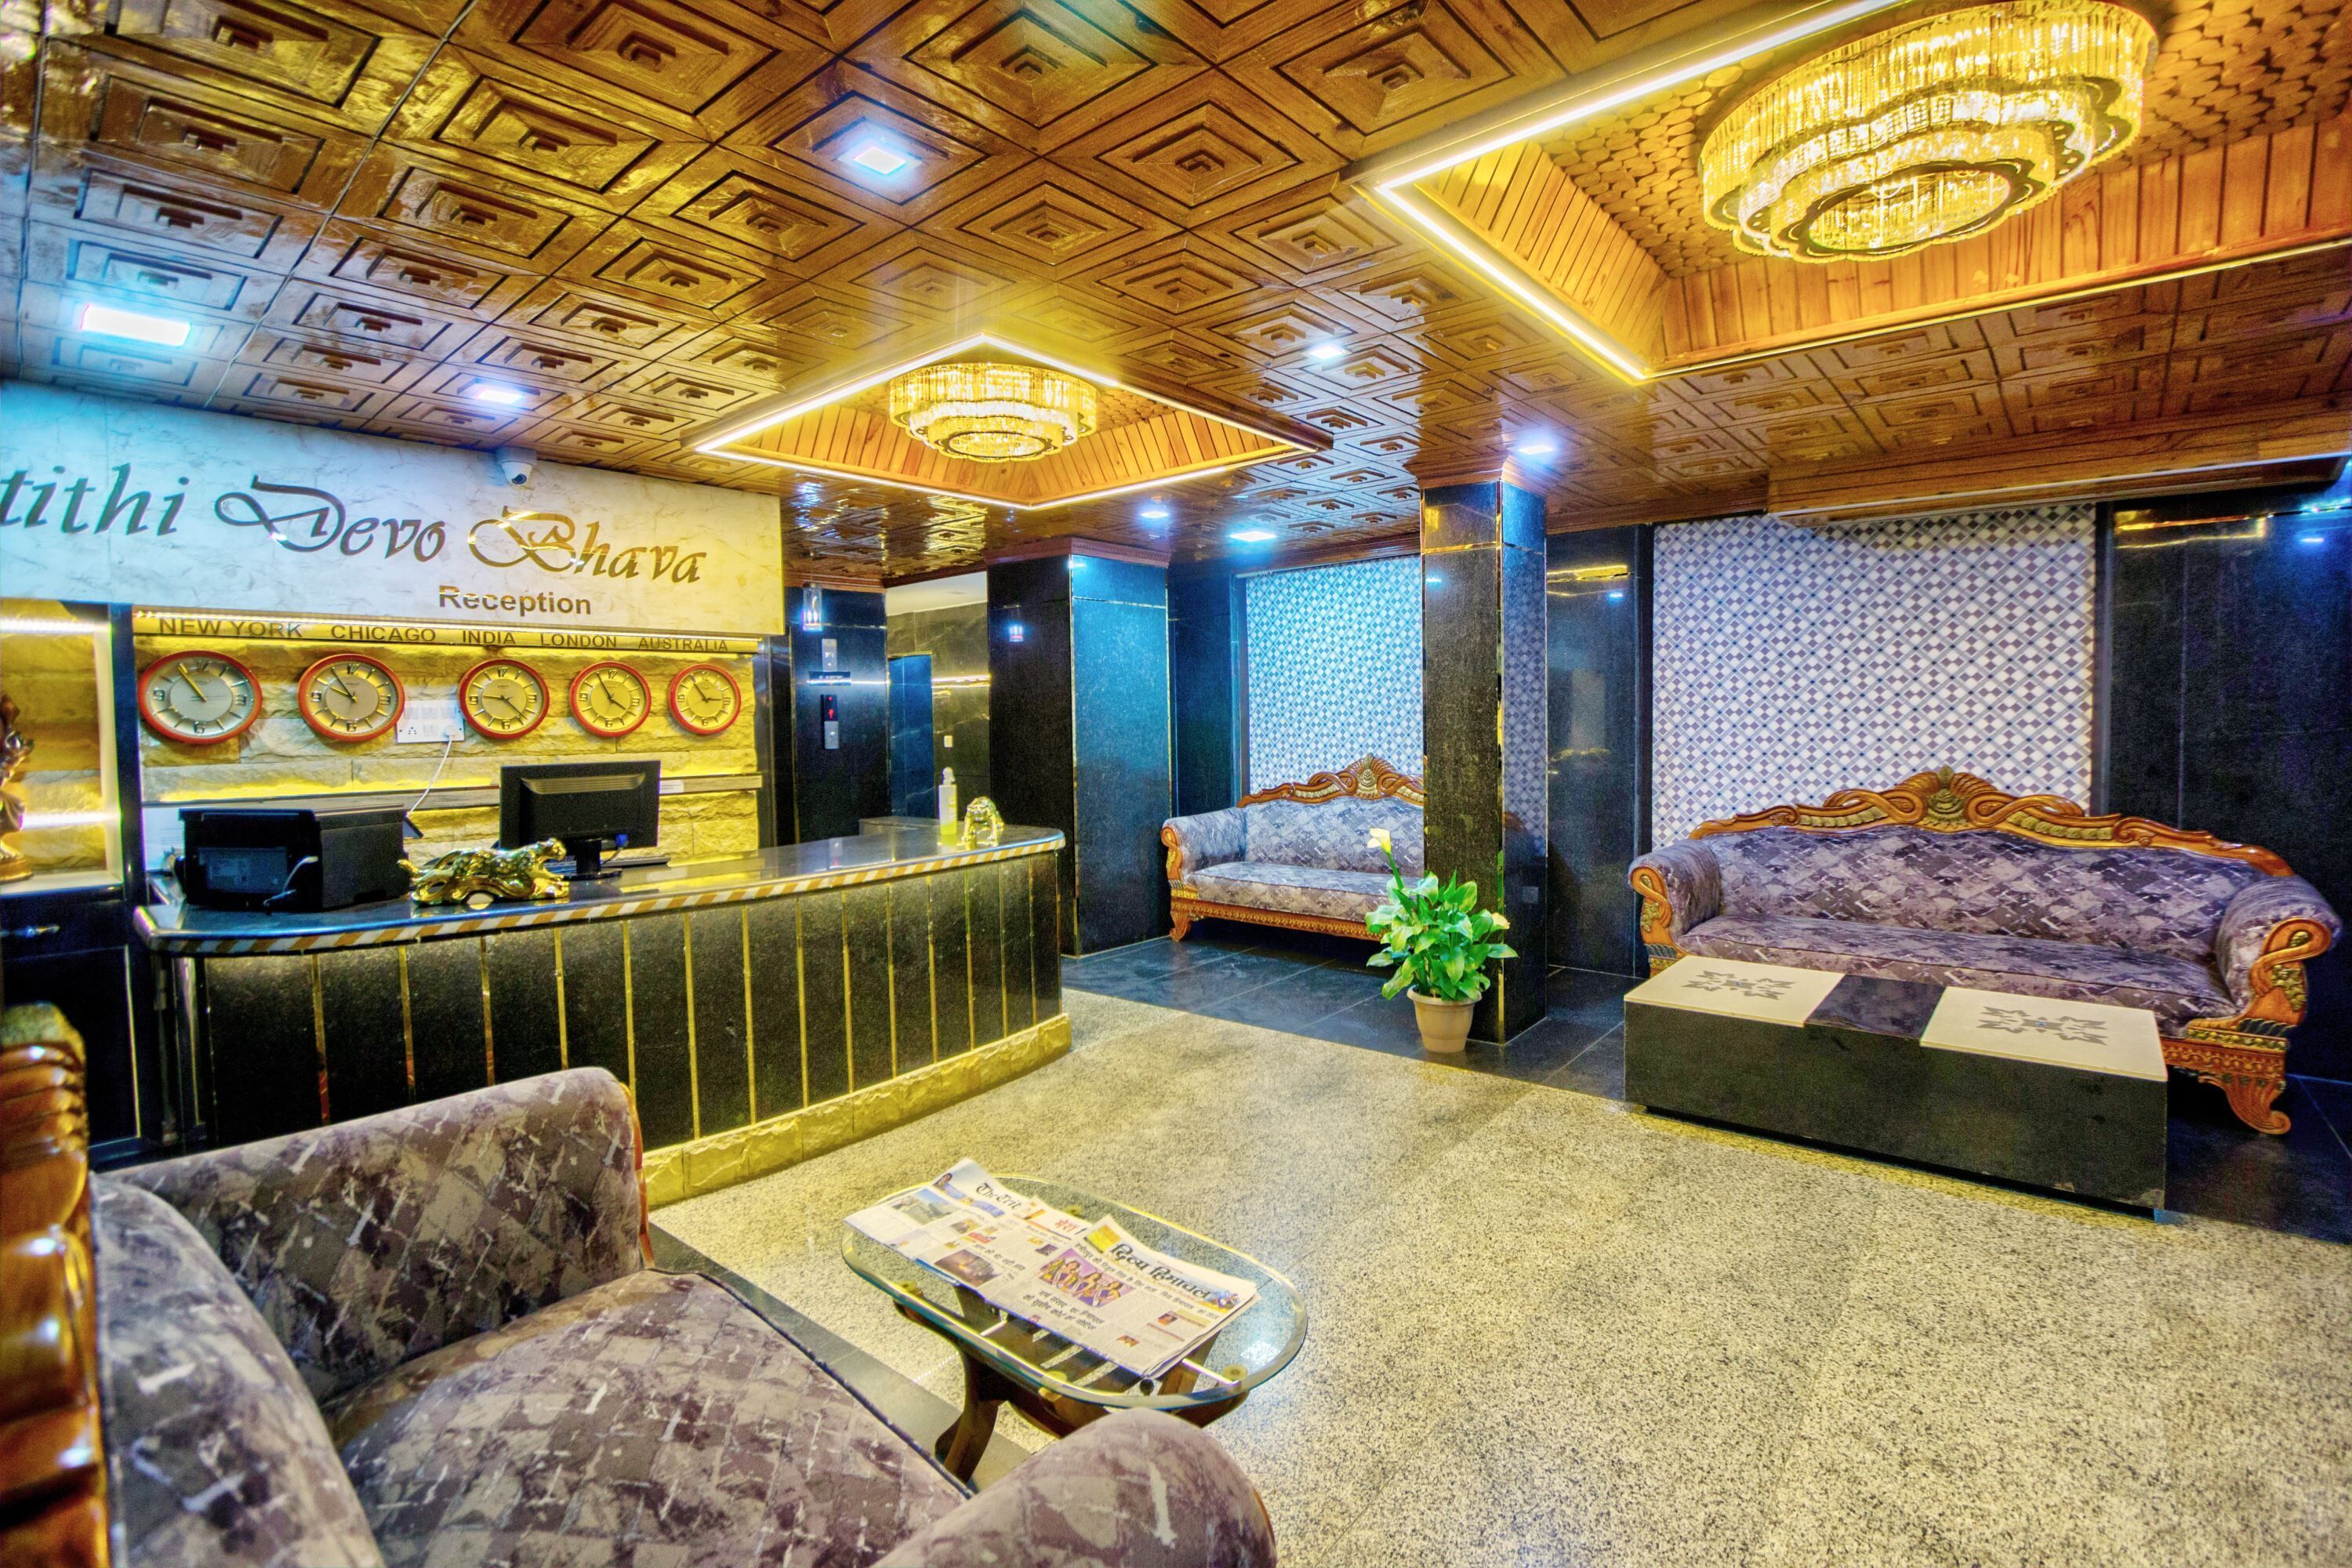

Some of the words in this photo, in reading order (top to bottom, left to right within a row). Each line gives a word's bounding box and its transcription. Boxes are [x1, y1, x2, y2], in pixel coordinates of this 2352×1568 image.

[214, 474, 446, 562] Devo
[467, 505, 707, 583] Bhava
[438, 585, 592, 616] Reception
[159, 617, 222, 636] NEW
[229, 620, 303, 639] YORK
[330, 624, 436, 643] CHICAGO
[462, 630, 517, 645] INDIA
[540, 632, 617, 649] LONDON
[638, 636, 728, 652] AUSTRALIA
[194, 720, 205, 734] 6
[605, 718, 613, 728] 6
[702, 717, 709, 726] 6
[975, 1182, 999, 1200] The
[1109, 1243, 1150, 1270] दिव्य
[1148, 1266, 1211, 1298] हिमाचल
